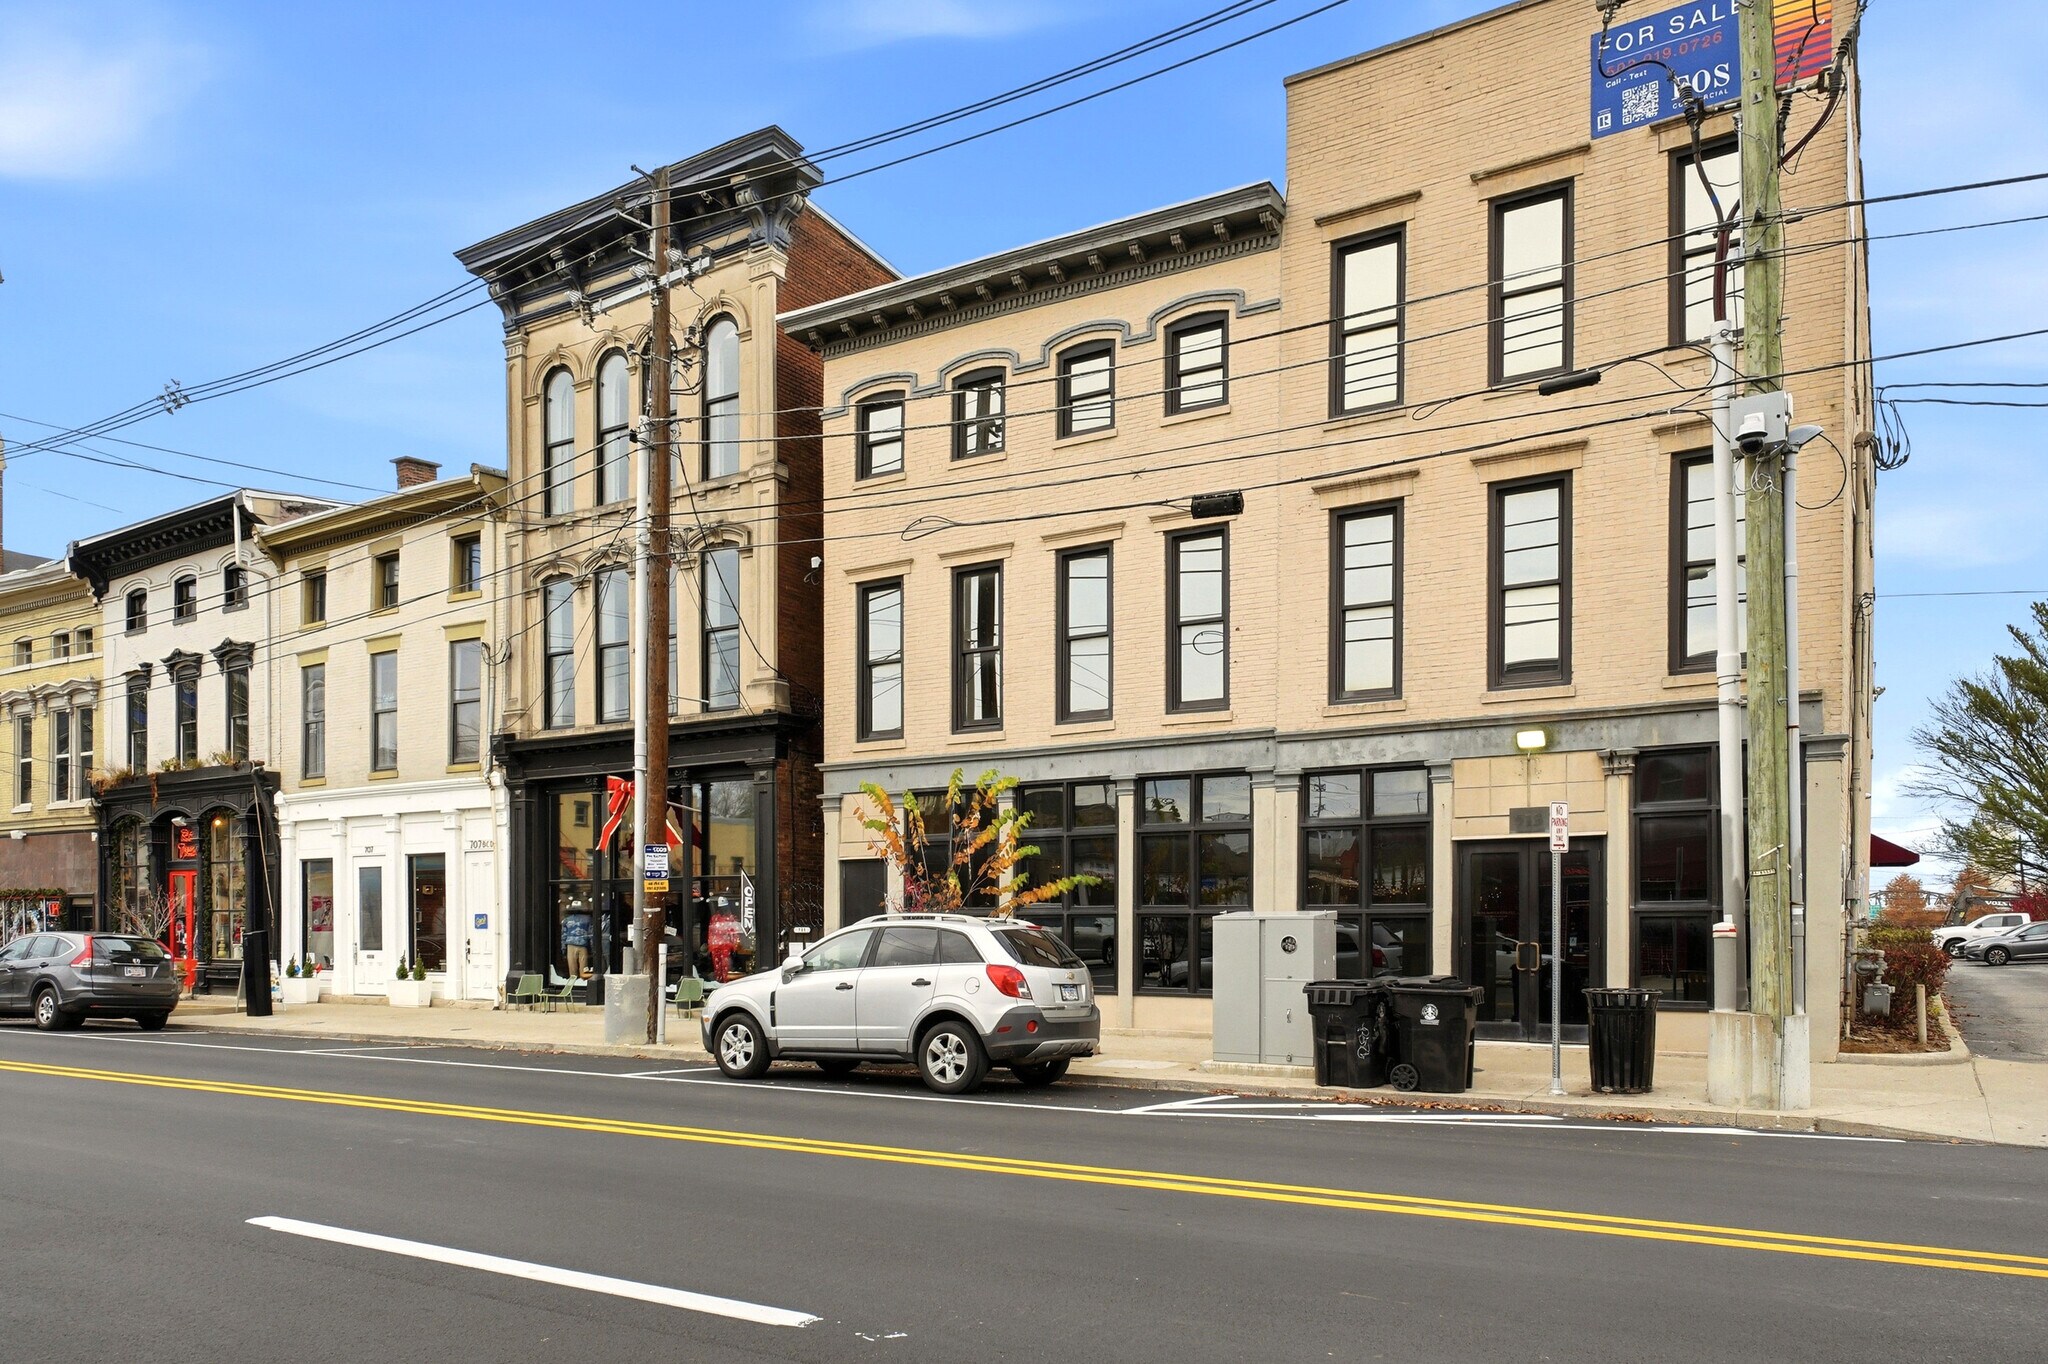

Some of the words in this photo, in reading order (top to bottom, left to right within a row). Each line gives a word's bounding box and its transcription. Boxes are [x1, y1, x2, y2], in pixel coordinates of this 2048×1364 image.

[1605, 78, 1621, 88] Call
[1555, 805, 1564, 816] NO
[743, 885, 754, 929] OPEN
